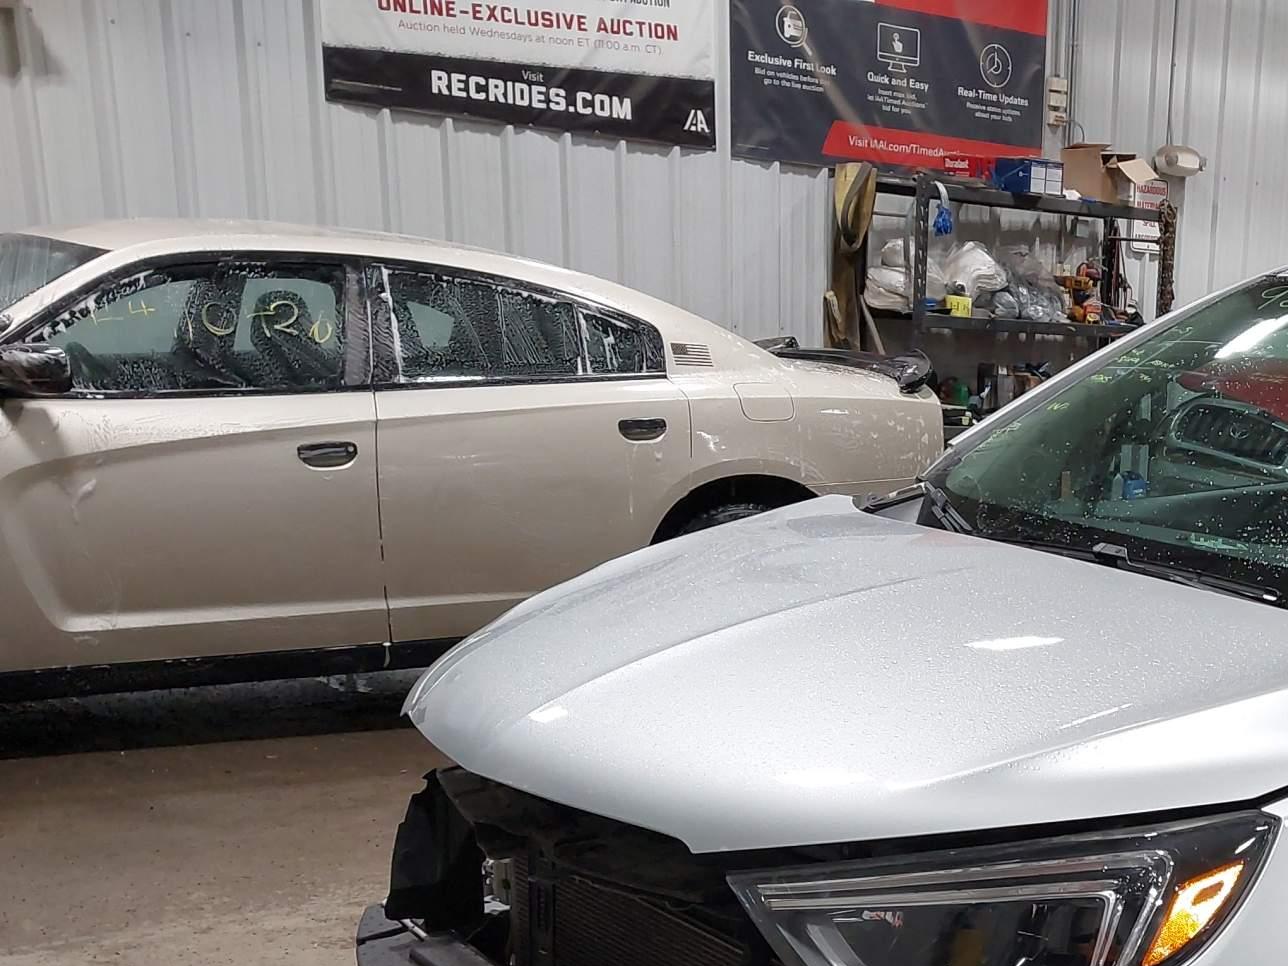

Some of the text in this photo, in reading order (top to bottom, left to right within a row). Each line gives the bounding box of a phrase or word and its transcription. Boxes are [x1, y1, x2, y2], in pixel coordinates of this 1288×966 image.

[377, 0, 679, 41] ONLINE-EXCLUSIVE AUCTION
[398, 19, 440, 32] Auction
[443, 23, 466, 35] held
[469, 26, 533, 43] Wednesdays
[535, 35, 545, 44] at
[549, 36, 574, 47] noon
[577, 37, 591, 47] ET
[748, 50, 837, 75] Exclusive First Look
[521, 70, 544, 83] Visit
[867, 71, 929, 92] Quick and Easy
[431, 70, 632, 120] RECRIDES.COM
[957, 86, 1029, 106] Real-Time Updates
[848, 135, 869, 148] Visit
